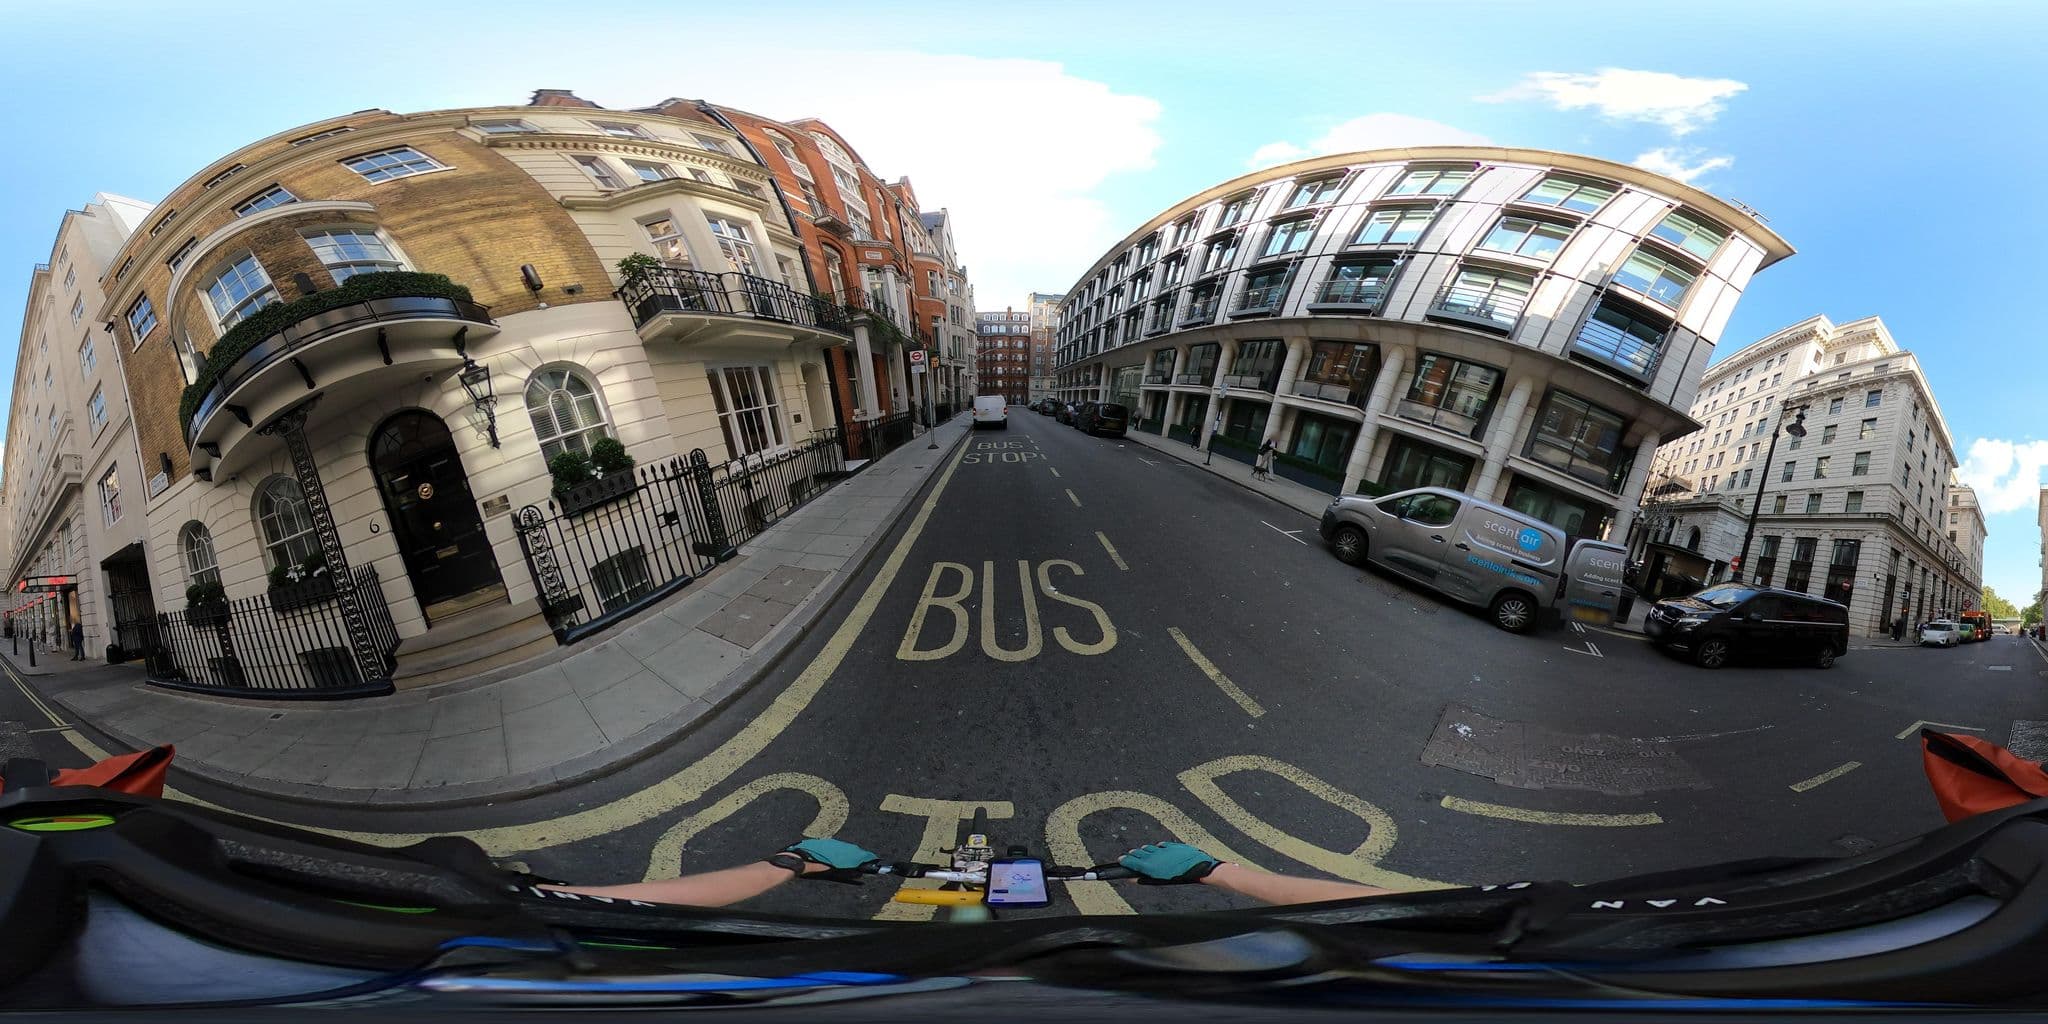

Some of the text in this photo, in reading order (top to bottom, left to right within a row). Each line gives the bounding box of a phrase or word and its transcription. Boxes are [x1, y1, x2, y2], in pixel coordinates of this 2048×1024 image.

[977, 441, 1023, 450] BUS
[963, 452, 1037, 464] STOP
[369, 517, 379, 534] 6
[1483, 520, 1540, 547] scentair
[1589, 557, 1625, 572] scent
[896, 559, 1118, 662] BUS
